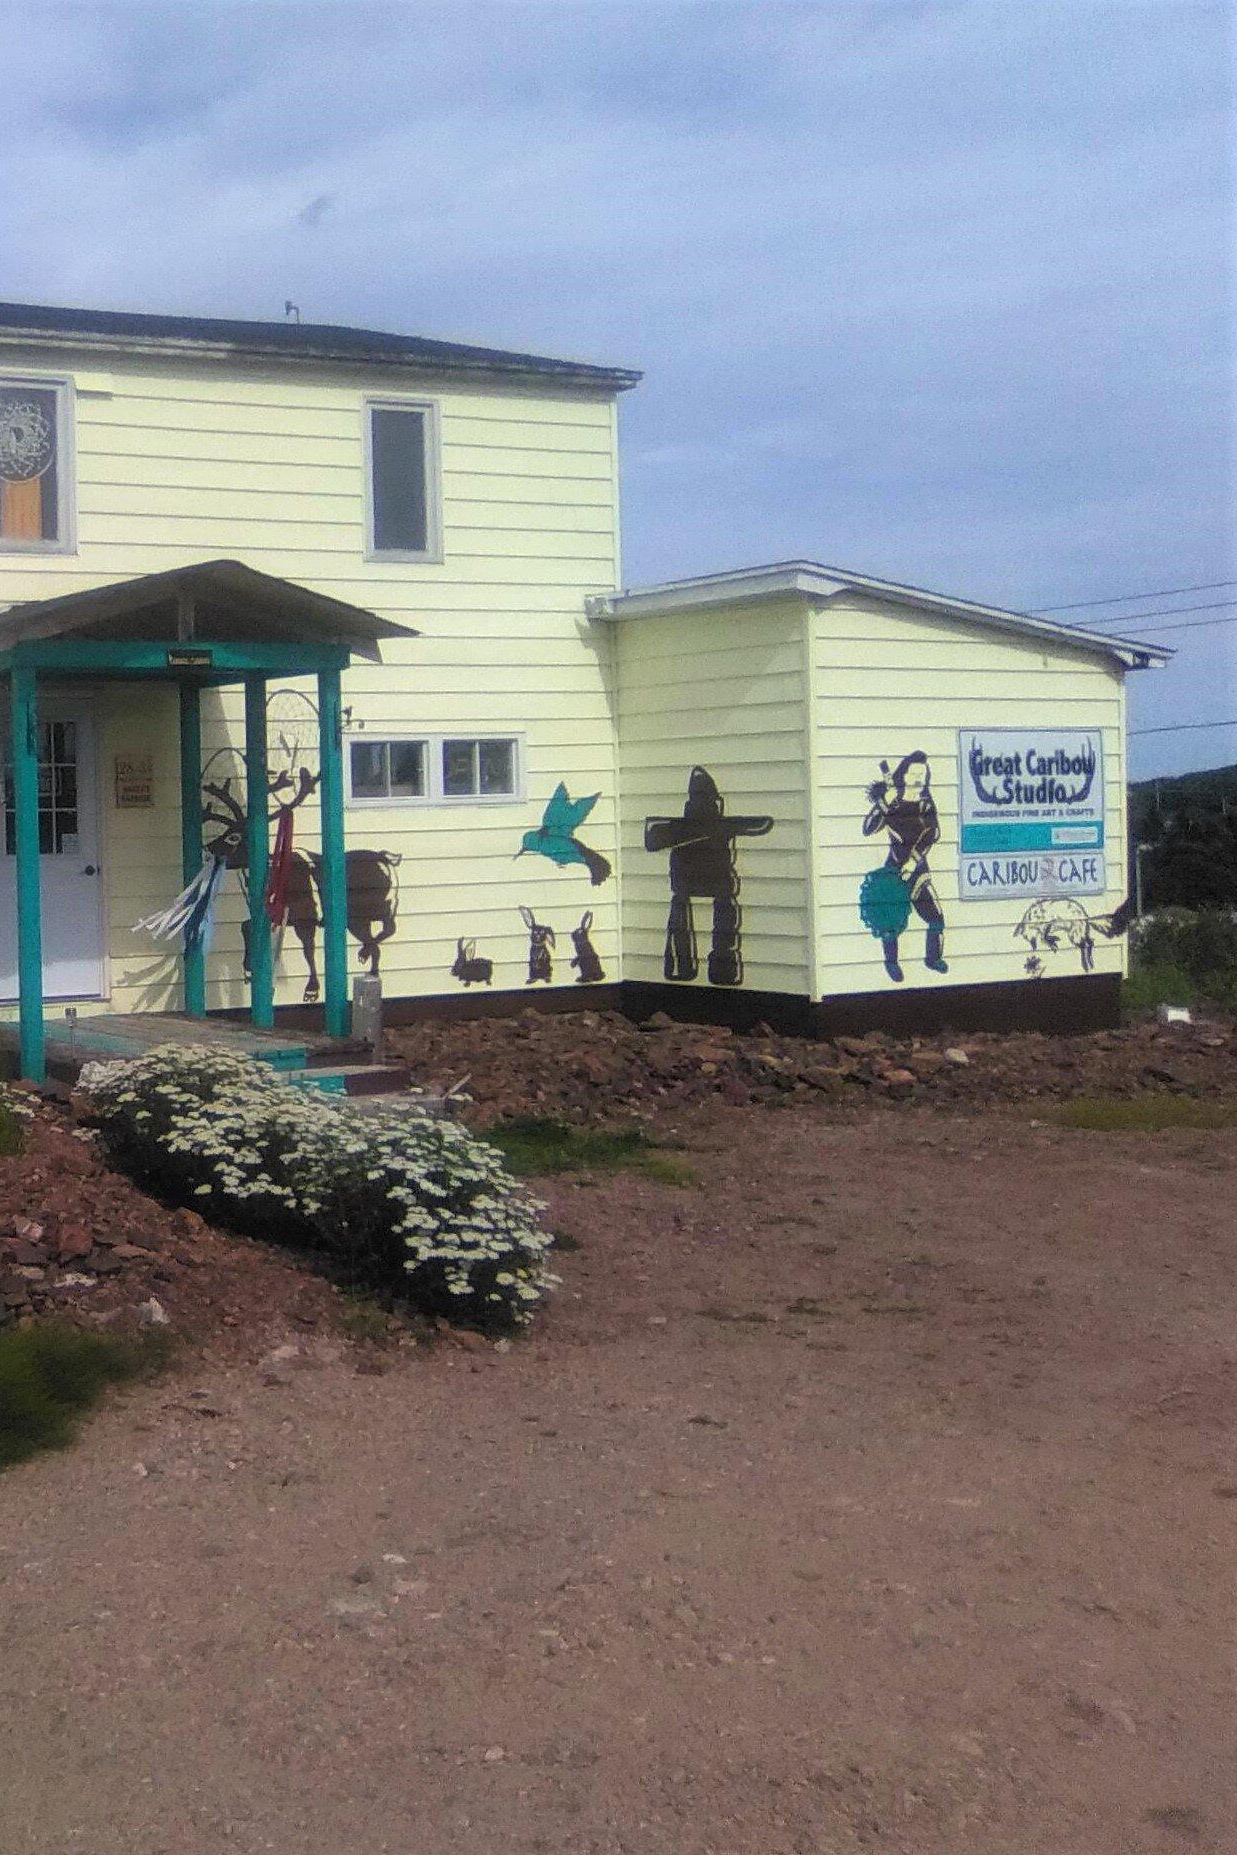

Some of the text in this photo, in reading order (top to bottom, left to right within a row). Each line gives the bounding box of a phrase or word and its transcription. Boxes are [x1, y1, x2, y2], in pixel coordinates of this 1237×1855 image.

[971, 748, 1095, 776] Great Caribou
[1003, 778, 1067, 804] Studio
[967, 858, 1097, 886] CARIBOU CAFE
